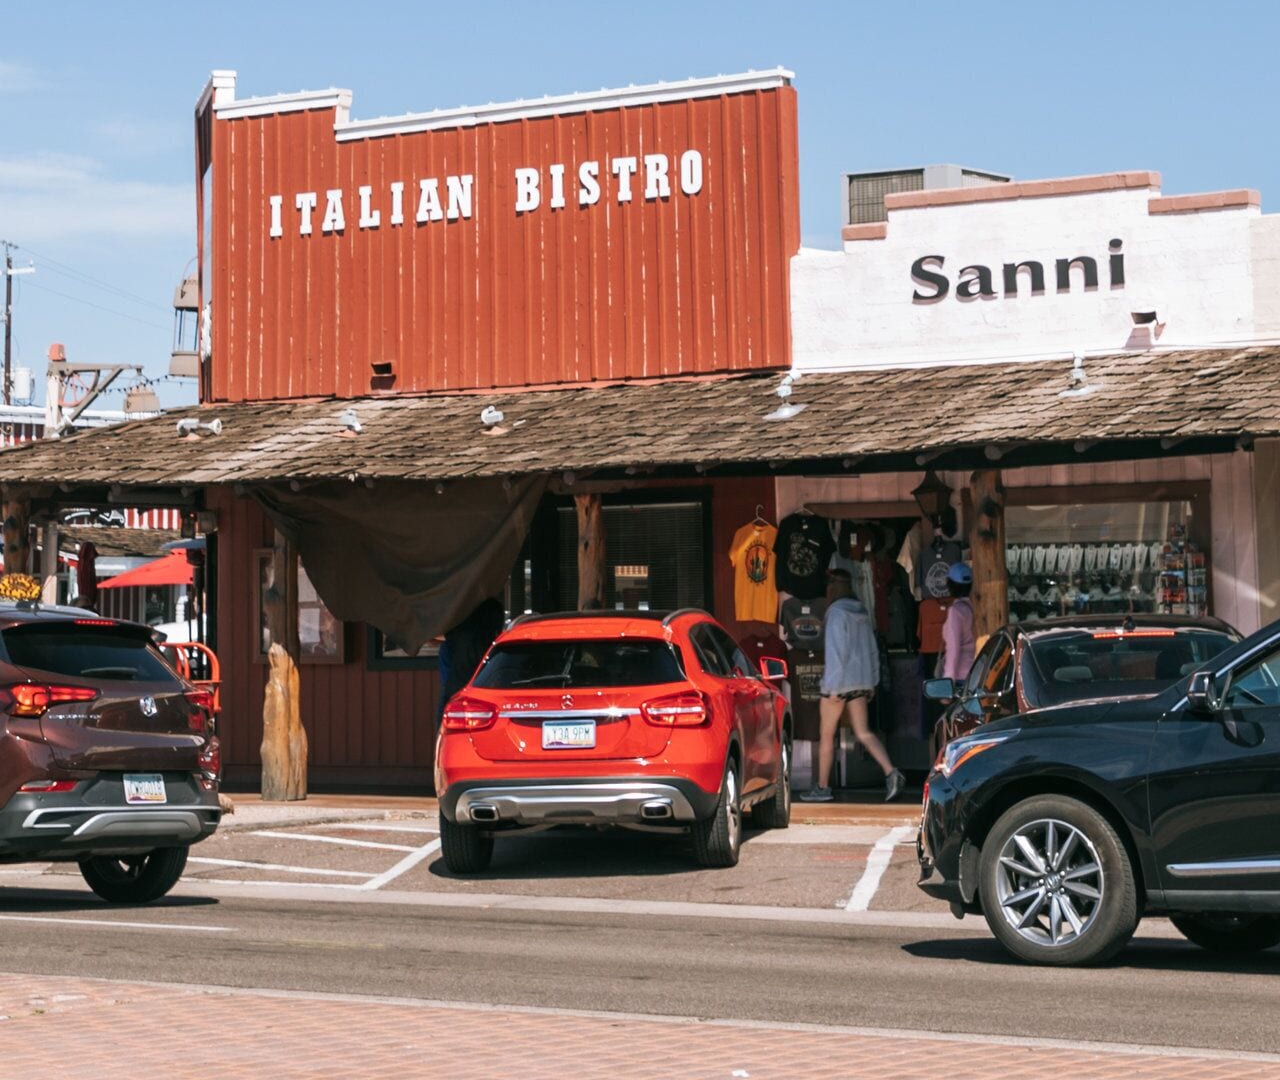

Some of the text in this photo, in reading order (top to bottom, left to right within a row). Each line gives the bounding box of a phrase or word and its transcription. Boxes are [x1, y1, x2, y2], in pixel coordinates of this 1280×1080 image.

[269, 149, 703, 237] ITALIAN BISTRO
[911, 238, 1124, 302] Sanni
